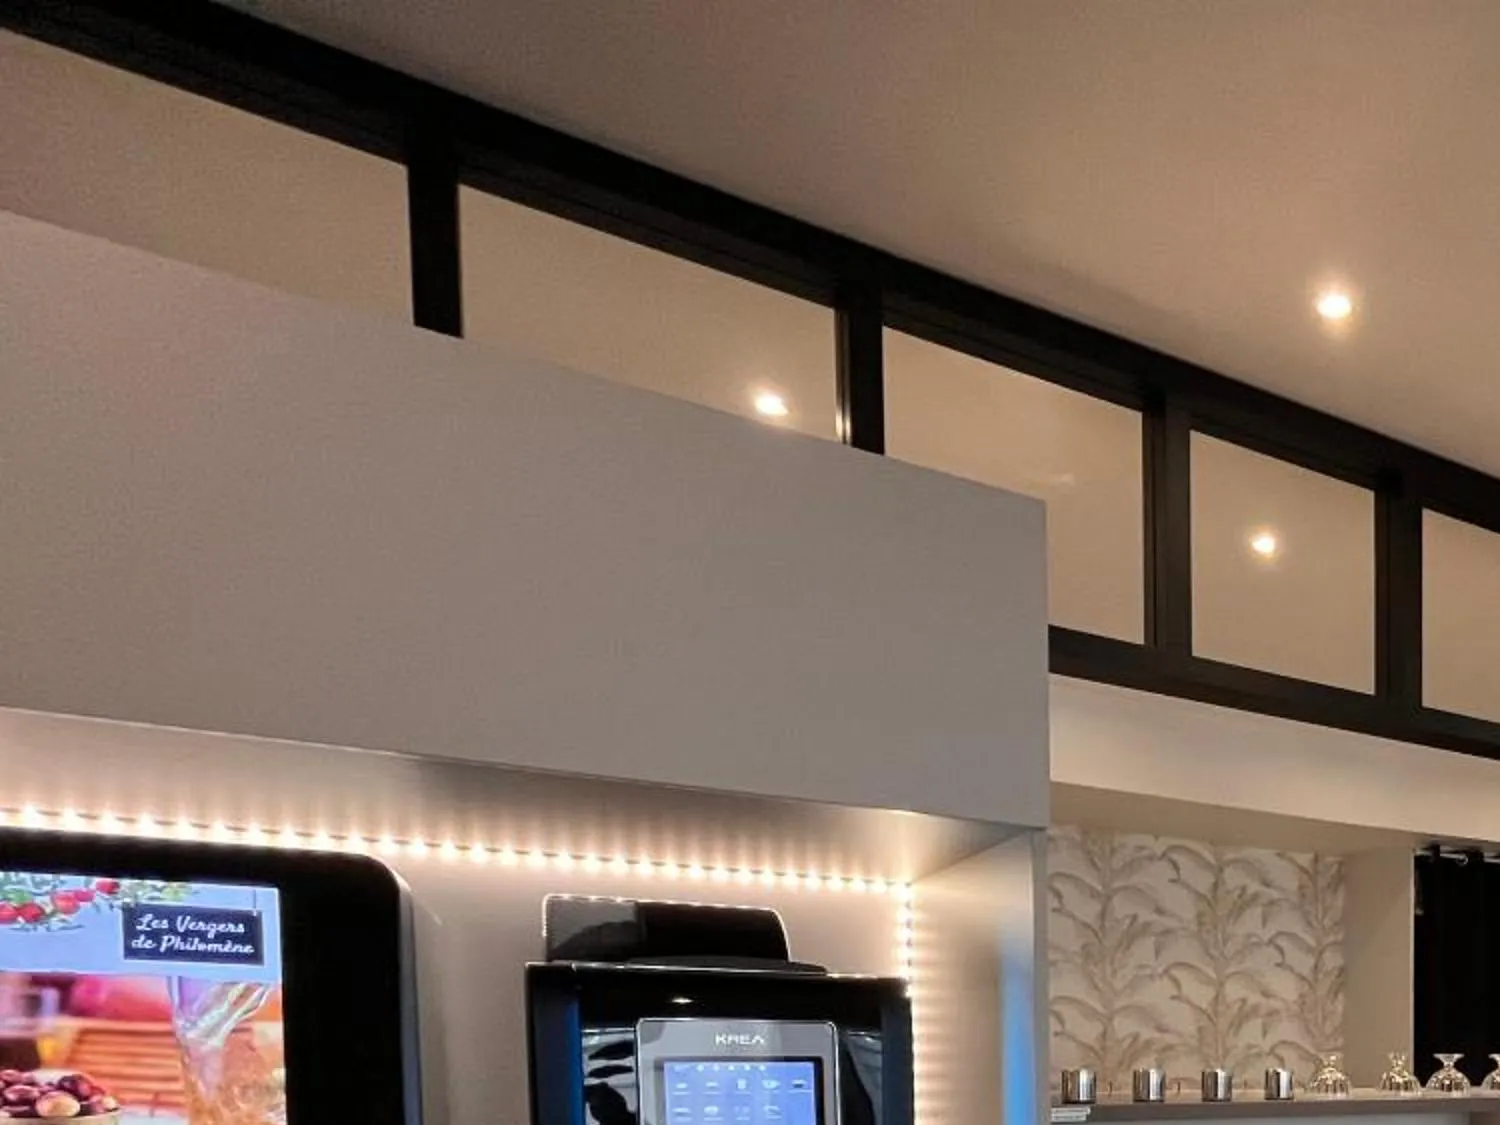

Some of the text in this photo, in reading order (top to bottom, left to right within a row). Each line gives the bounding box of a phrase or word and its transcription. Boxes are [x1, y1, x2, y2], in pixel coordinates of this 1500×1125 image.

[135, 913, 245, 939] Les Vergers
[131, 935, 158, 949] de
